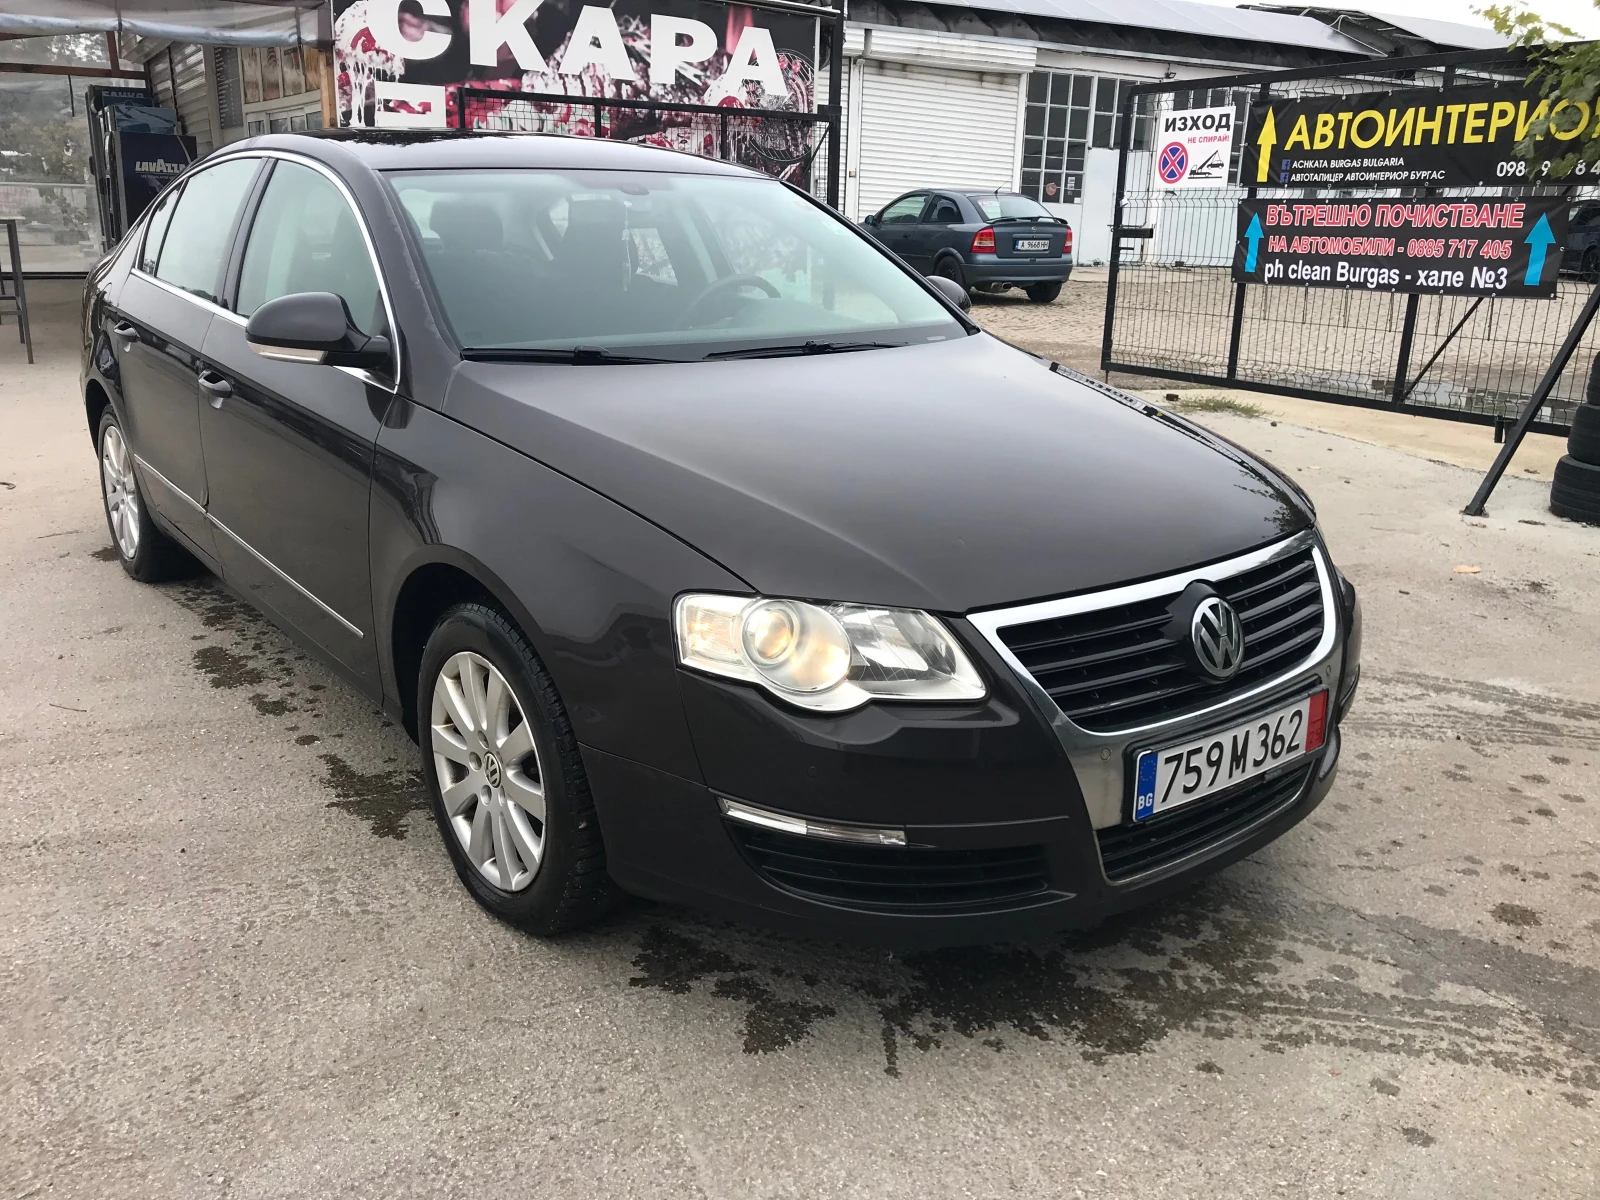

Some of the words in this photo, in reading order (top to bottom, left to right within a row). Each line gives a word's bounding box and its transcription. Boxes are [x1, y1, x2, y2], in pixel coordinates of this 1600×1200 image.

[366, 0, 789, 98] СКАРА
[1164, 113, 1231, 132] ИЗХОД
[1283, 98, 1600, 151] АВТОИНТЕРИО
[1187, 136, 1197, 144] НЕ
[1198, 134, 1230, 143] СПИРАЙ!
[1292, 159, 1328, 169] ACHKATA
[1330, 158, 1361, 168] BURGAS
[1363, 157, 1405, 167] BULGARIA
[1290, 172, 1344, 183] АВТОТАПИЦЕР
[1345, 171, 1409, 181] АВТОИНТЕРИОР
[1410, 170, 1446, 180] БУРГАС
[1266, 204, 1372, 227] ВЪТРЕШНО
[1375, 203, 1526, 228] ПОЧИСТВАНЕ
[1268, 235, 1287, 252] НА
[1289, 236, 1396, 256] АВТОМОБИЛИ
[1407, 238, 1445, 258] 0885
[1448, 239, 1478, 258] 717
[1480, 240, 1513, 260] 405
[1264, 259, 1284, 282] ph
[1288, 260, 1331, 280] clean
[1336, 261, 1399, 288] Burgas
[1416, 269, 1465, 287] хале
[1470, 266, 1508, 289] №3
[1137, 793, 1153, 810] BG
